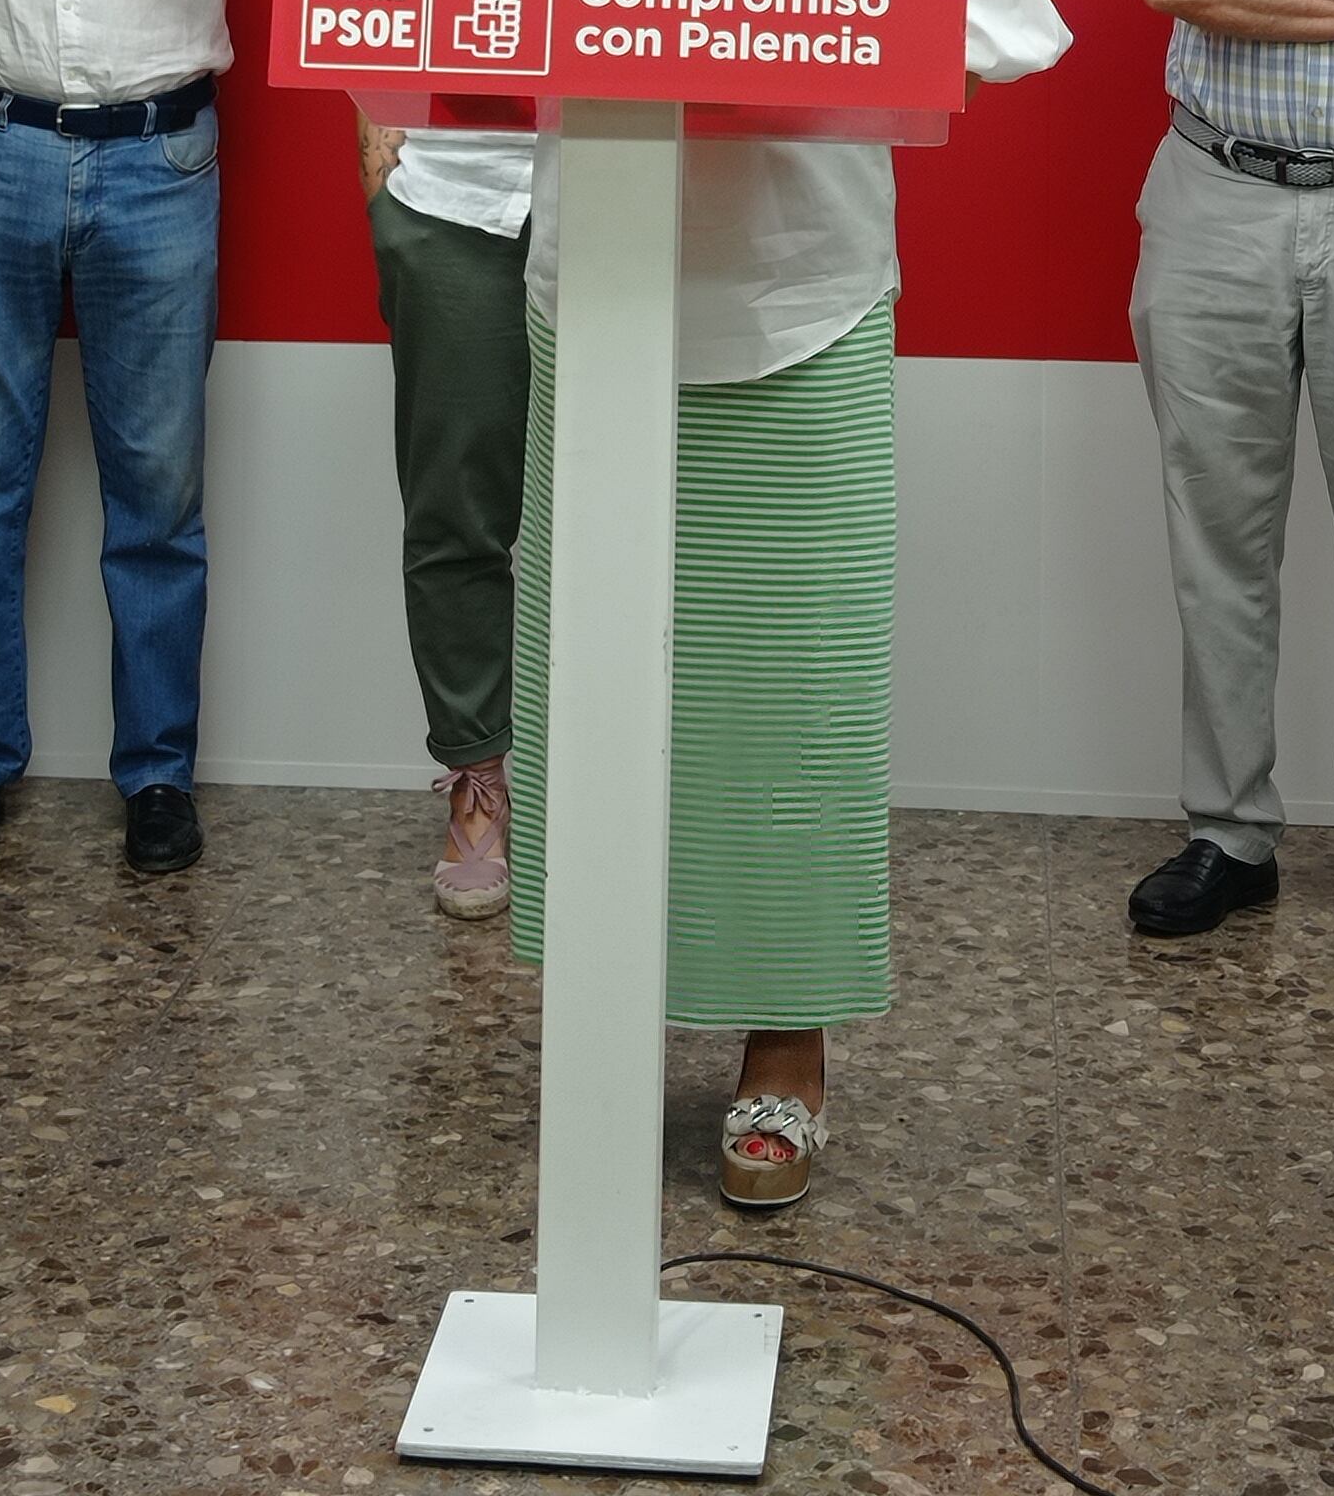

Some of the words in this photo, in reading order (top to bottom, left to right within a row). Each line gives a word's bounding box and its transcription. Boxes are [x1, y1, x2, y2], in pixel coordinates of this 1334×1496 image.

[310, 7, 417, 48] PSOE
[575, 25, 663, 57] con
[679, 21, 881, 66] Palencia
